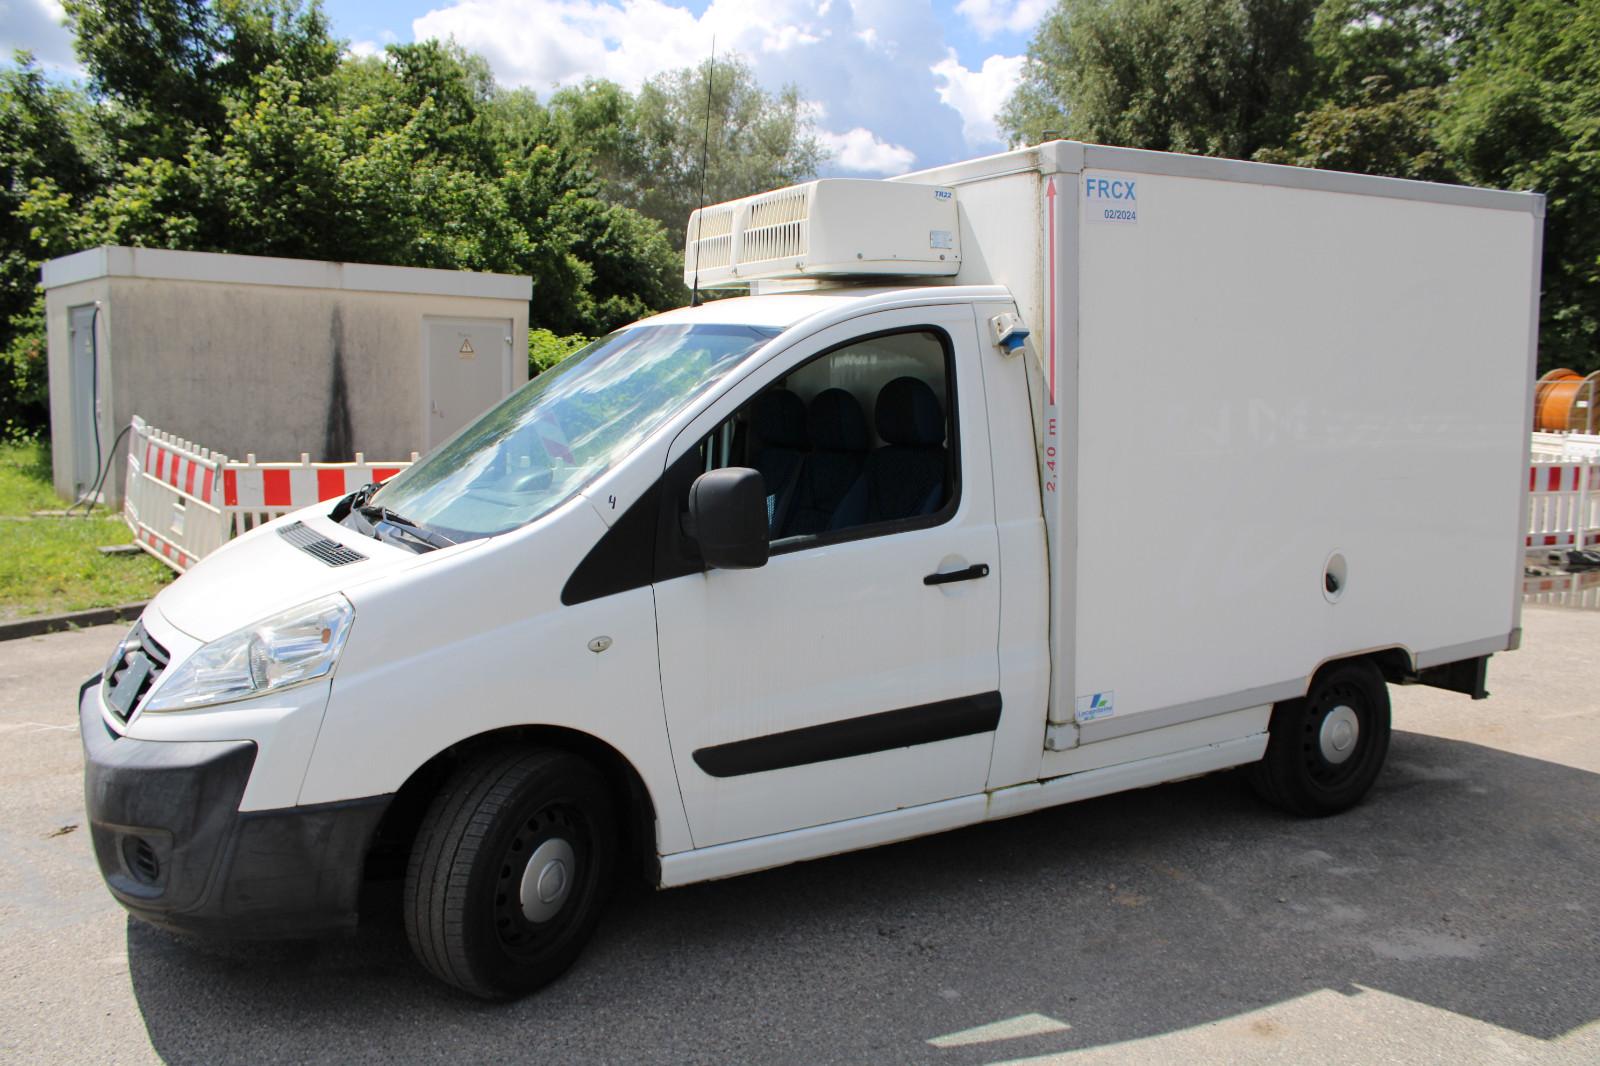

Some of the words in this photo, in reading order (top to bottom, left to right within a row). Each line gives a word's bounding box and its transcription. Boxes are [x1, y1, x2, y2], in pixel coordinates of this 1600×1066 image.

[1086, 178, 1136, 200] FRCX
[1104, 209, 1136, 221] 02/2024
[1048, 418, 1057, 436] m
